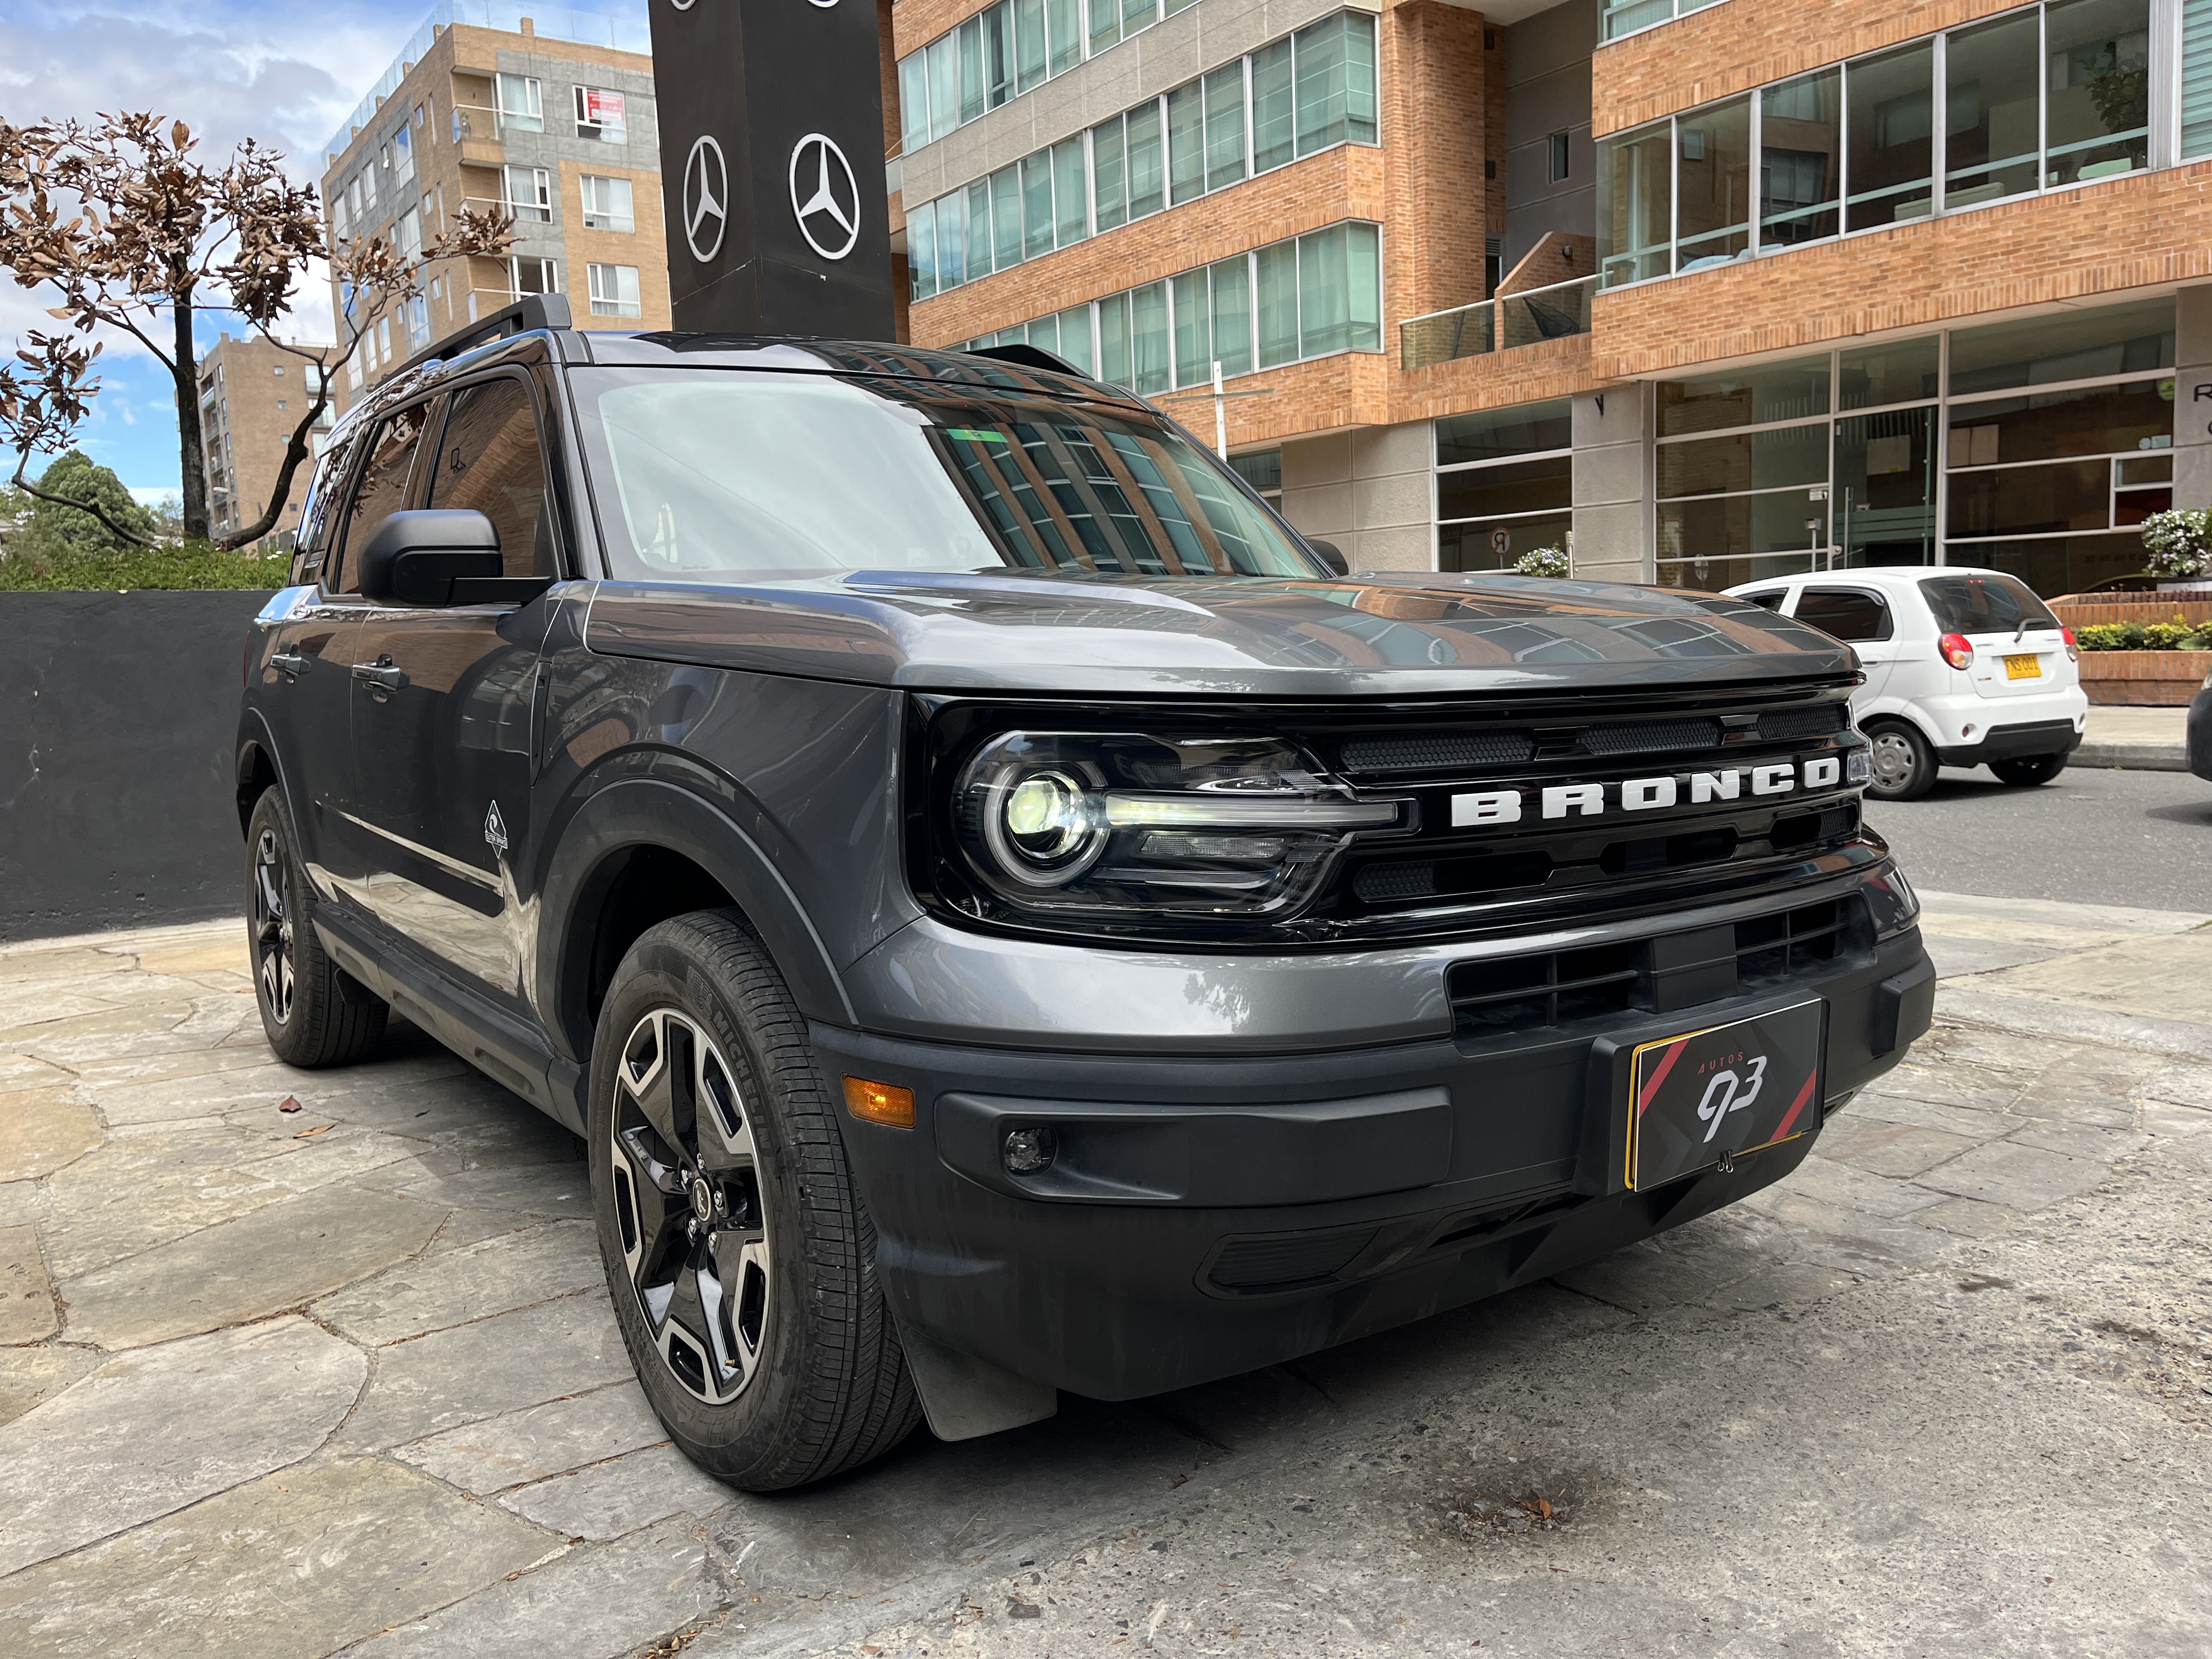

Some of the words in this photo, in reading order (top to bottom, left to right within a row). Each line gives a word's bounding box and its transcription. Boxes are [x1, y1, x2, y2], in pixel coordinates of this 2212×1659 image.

[1451, 758, 1839, 827] BRONCO
[713, 1011, 771, 1149] MICHELIN
[1697, 1051, 1743, 1074] AUTOS
